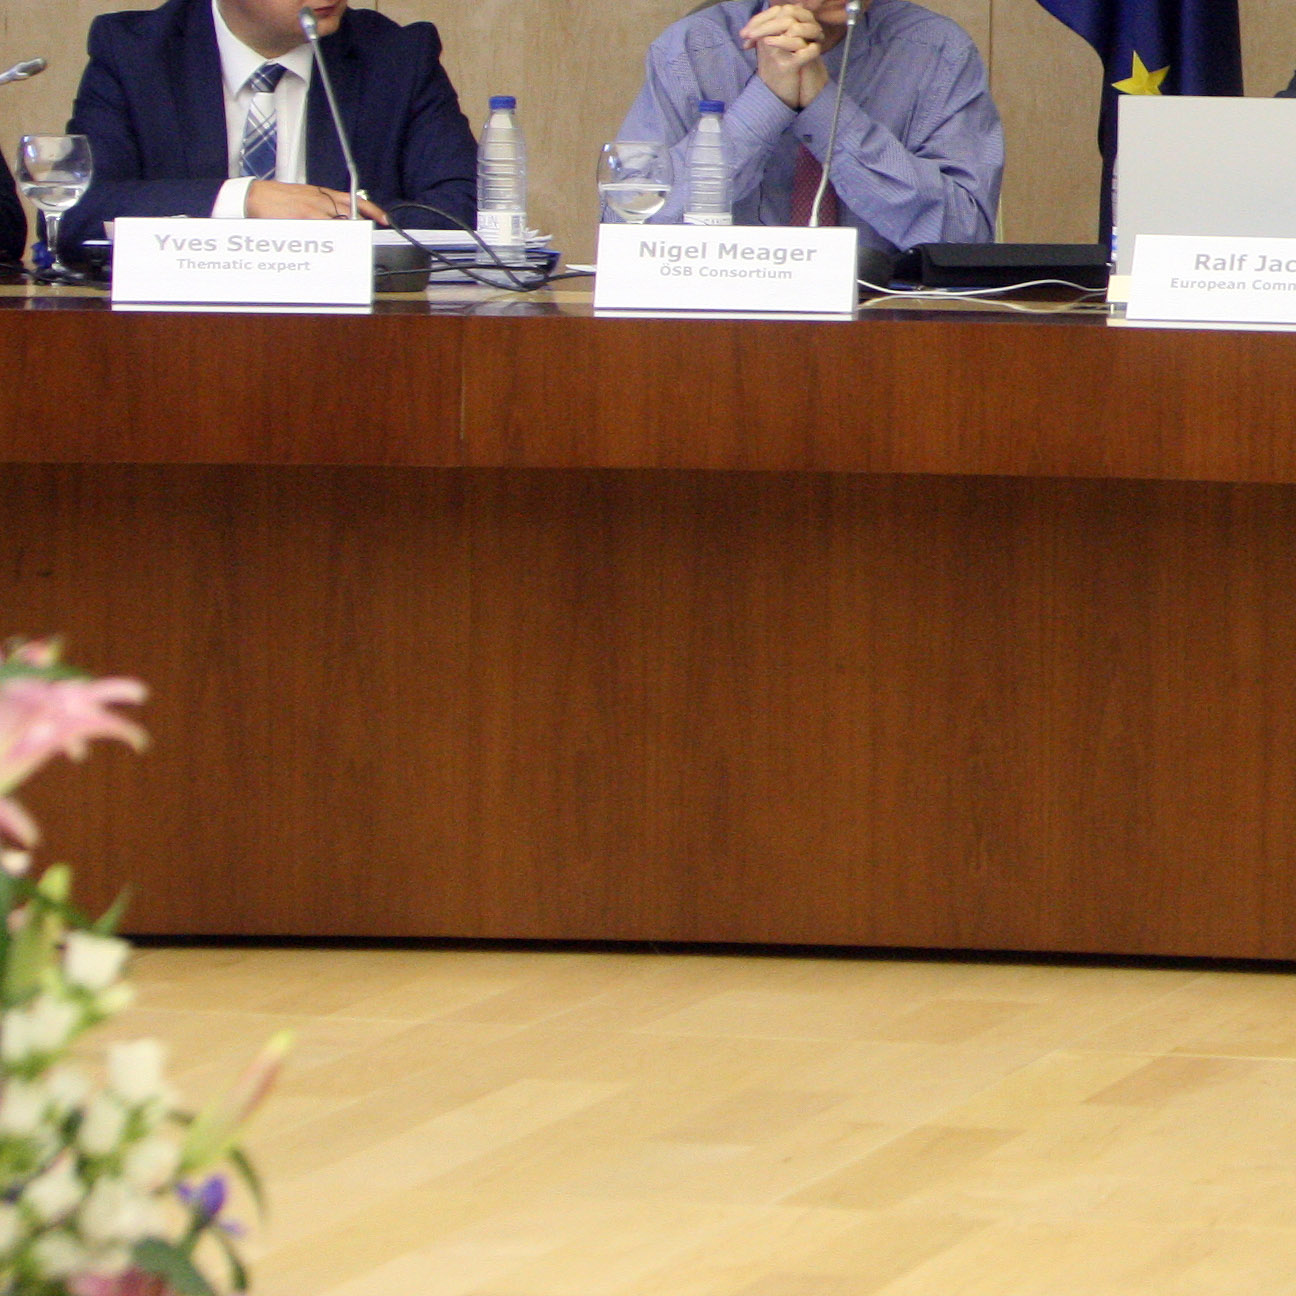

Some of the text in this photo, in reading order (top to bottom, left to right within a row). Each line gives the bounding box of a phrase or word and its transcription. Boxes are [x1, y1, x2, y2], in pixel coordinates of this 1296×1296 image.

[155, 234, 334, 253] Yves Stevens
[640, 241, 817, 265] Nigel Meager
[177, 259, 310, 273] Thematic expert
[660, 262, 792, 279] ÖSB Consortium
[1195, 254, 1247, 271] Ralf
[1171, 278, 1246, 291] European
